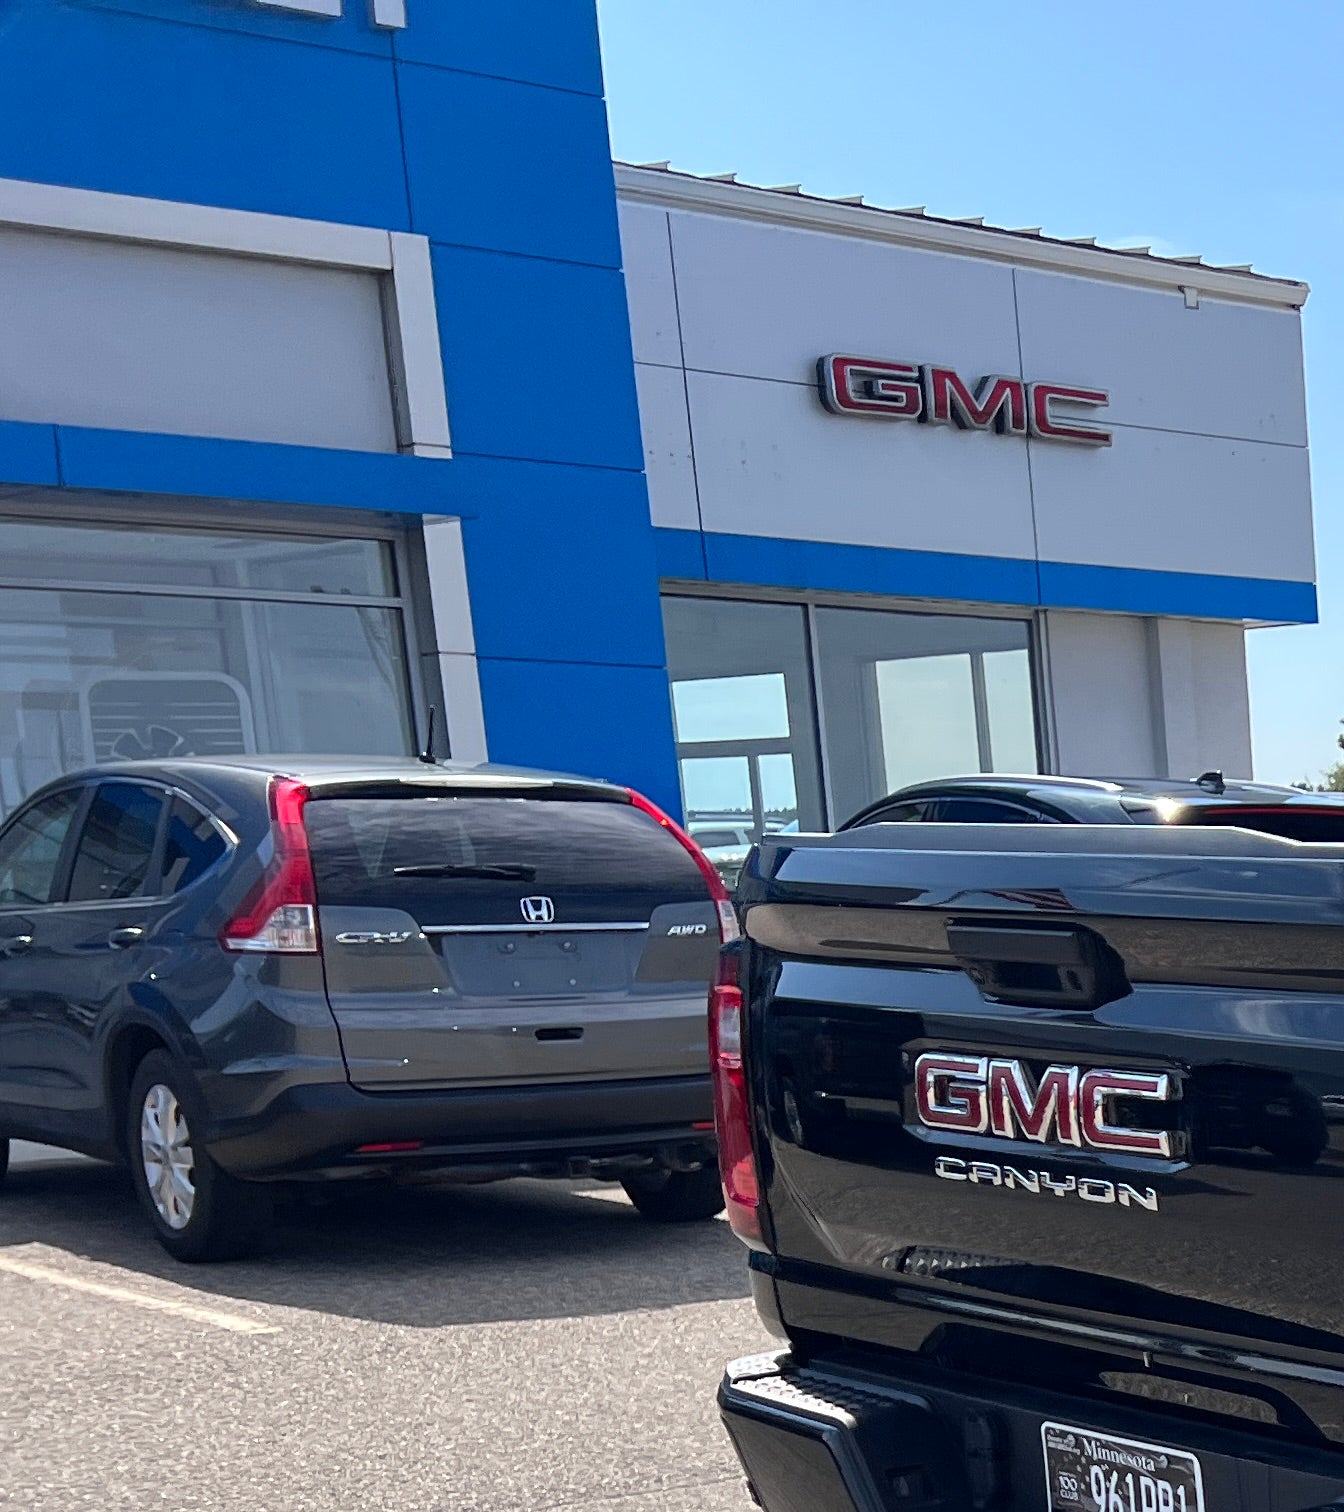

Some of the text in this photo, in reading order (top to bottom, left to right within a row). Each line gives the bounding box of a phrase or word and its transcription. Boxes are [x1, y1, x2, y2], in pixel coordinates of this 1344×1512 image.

[816, 353, 1113, 446] GMC
[335, 931, 413, 944] CR-V
[667, 924, 707, 936] AWD
[914, 1052, 1171, 1158] GMC
[934, 1156, 1159, 1212] CANYON
[1081, 1437, 1155, 1472] Minnesota
